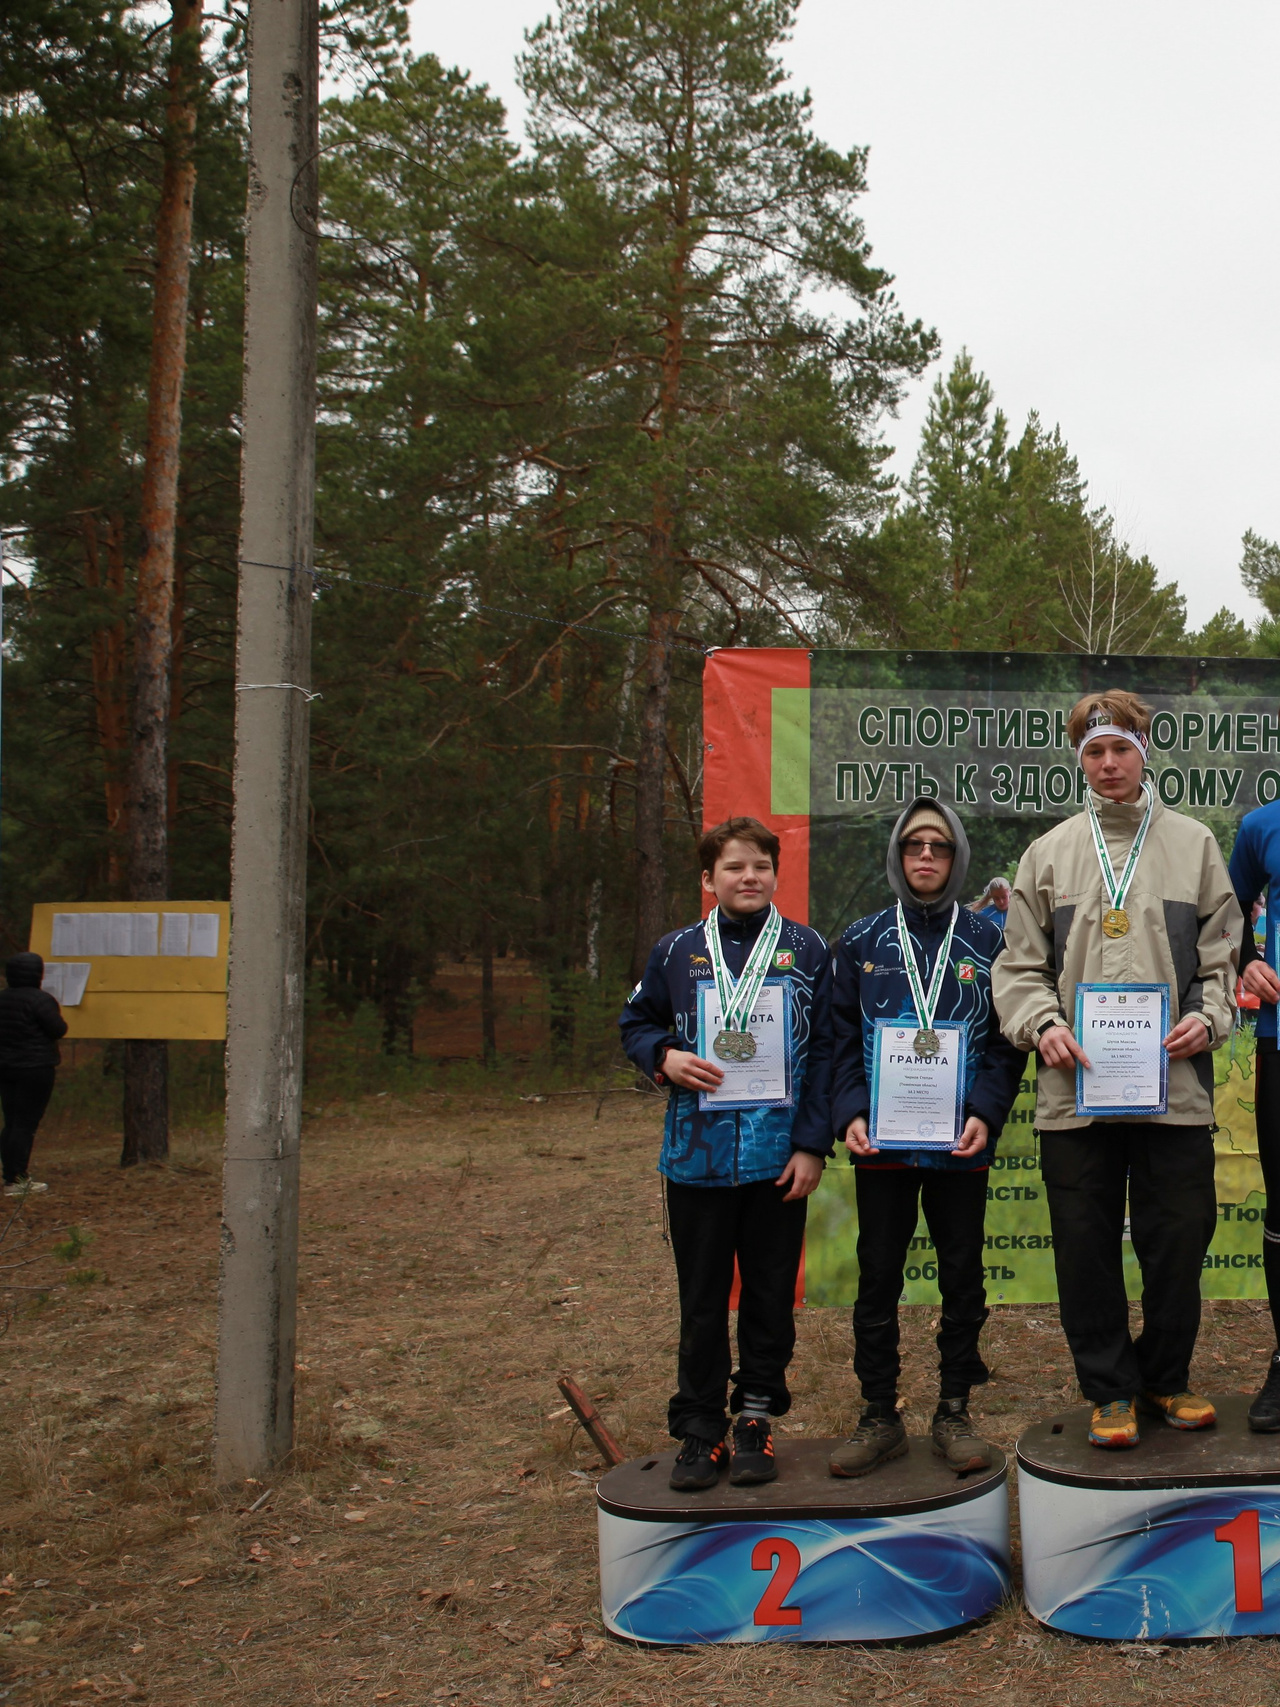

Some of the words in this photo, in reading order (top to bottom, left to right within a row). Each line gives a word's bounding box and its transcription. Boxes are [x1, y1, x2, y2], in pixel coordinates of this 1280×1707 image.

[858, 706, 1076, 750] СПОРТИВН
[836, 762, 940, 803] ПУТЬ
[954, 763, 978, 804] К
[714, 1014, 774, 1024] ГОТА
[1091, 1020, 1152, 1029] ГРАМОТА
[889, 1054, 949, 1066] ГРАМОТА
[750, 1536, 803, 1627] 2
[1213, 1508, 1263, 1613] 1
